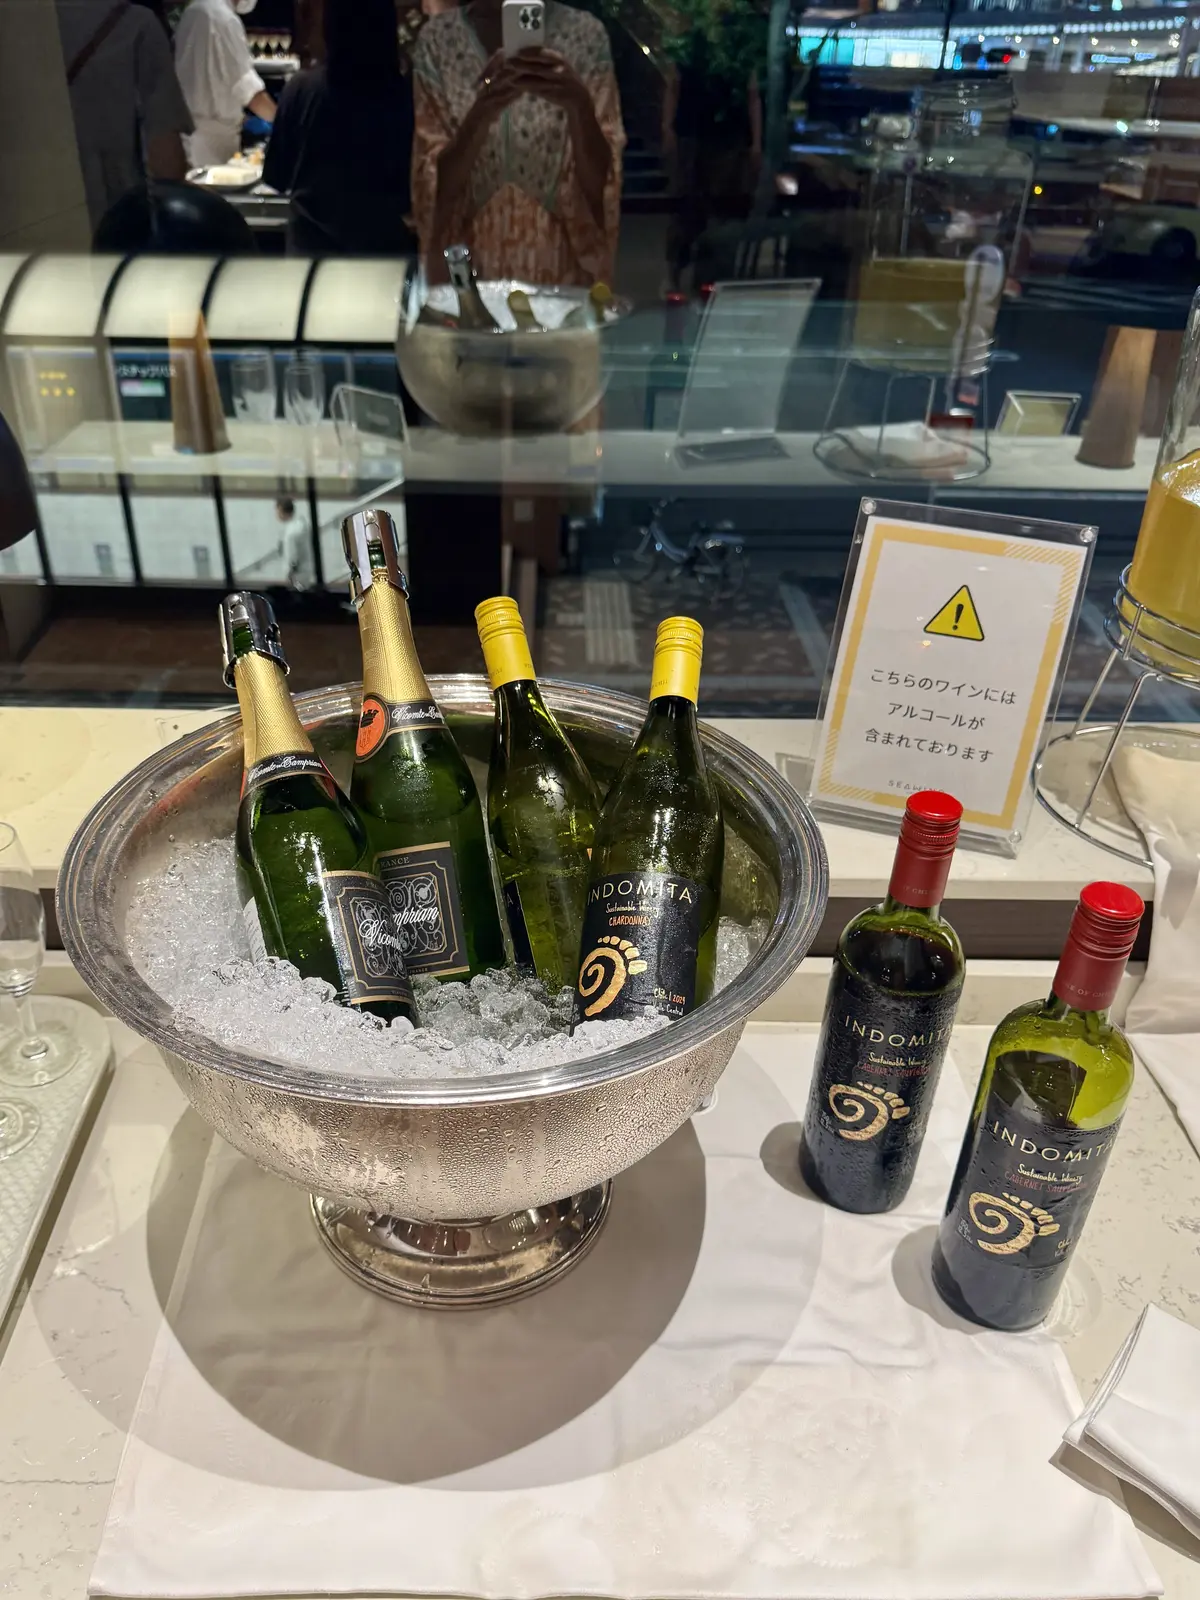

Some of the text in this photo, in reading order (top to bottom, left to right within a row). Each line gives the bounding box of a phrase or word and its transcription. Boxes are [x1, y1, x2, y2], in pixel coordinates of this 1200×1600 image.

[870, 668, 1018, 705] こちらのワインには
[887, 702, 986, 731] アルコールが
[865, 727, 994, 763] 含まれております
[587, 879, 693, 906] INDOMITA
[605, 901, 637, 914] Sustainable
[608, 914, 652, 928] CHARDONNAY
[868, 1051, 907, 1067] Sustainable
[992, 1120, 1114, 1163] INDOMITA
[1004, 1170, 1044, 1191] CABERNET
[1017, 1163, 1059, 1183] Sustainable
